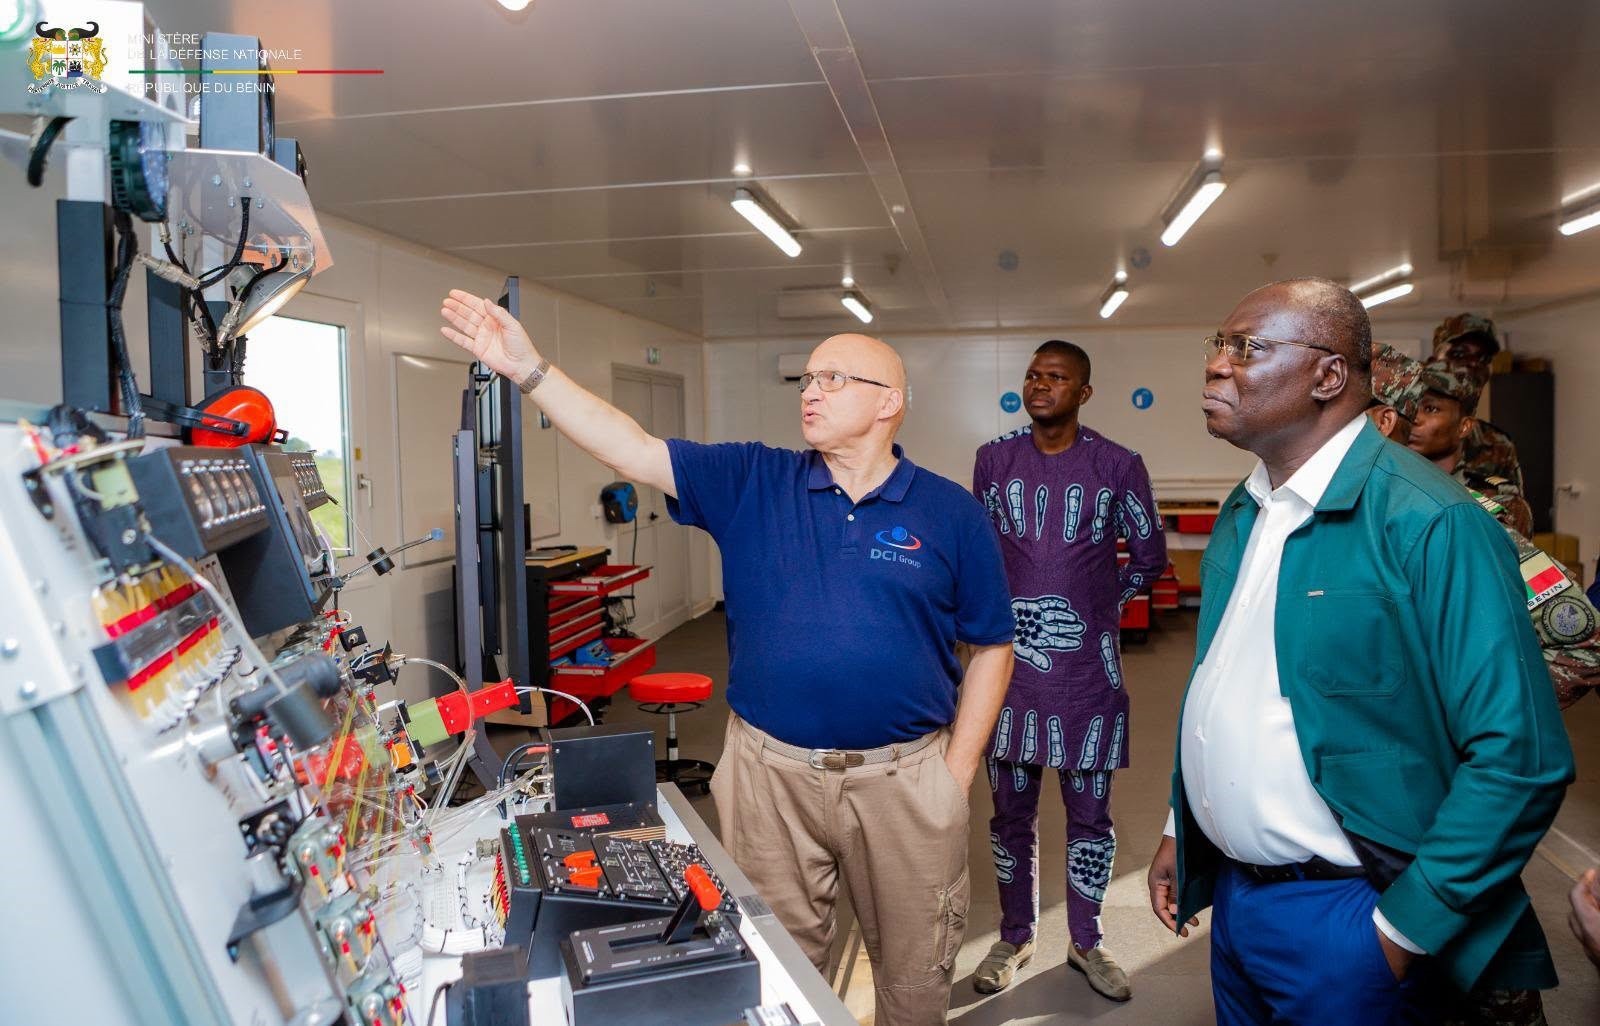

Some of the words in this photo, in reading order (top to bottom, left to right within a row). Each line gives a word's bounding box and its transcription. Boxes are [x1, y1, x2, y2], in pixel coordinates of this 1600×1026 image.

[870, 549, 897, 561] DCI
[899, 554, 921, 568] Group
[1527, 583, 1563, 607] BENIN
